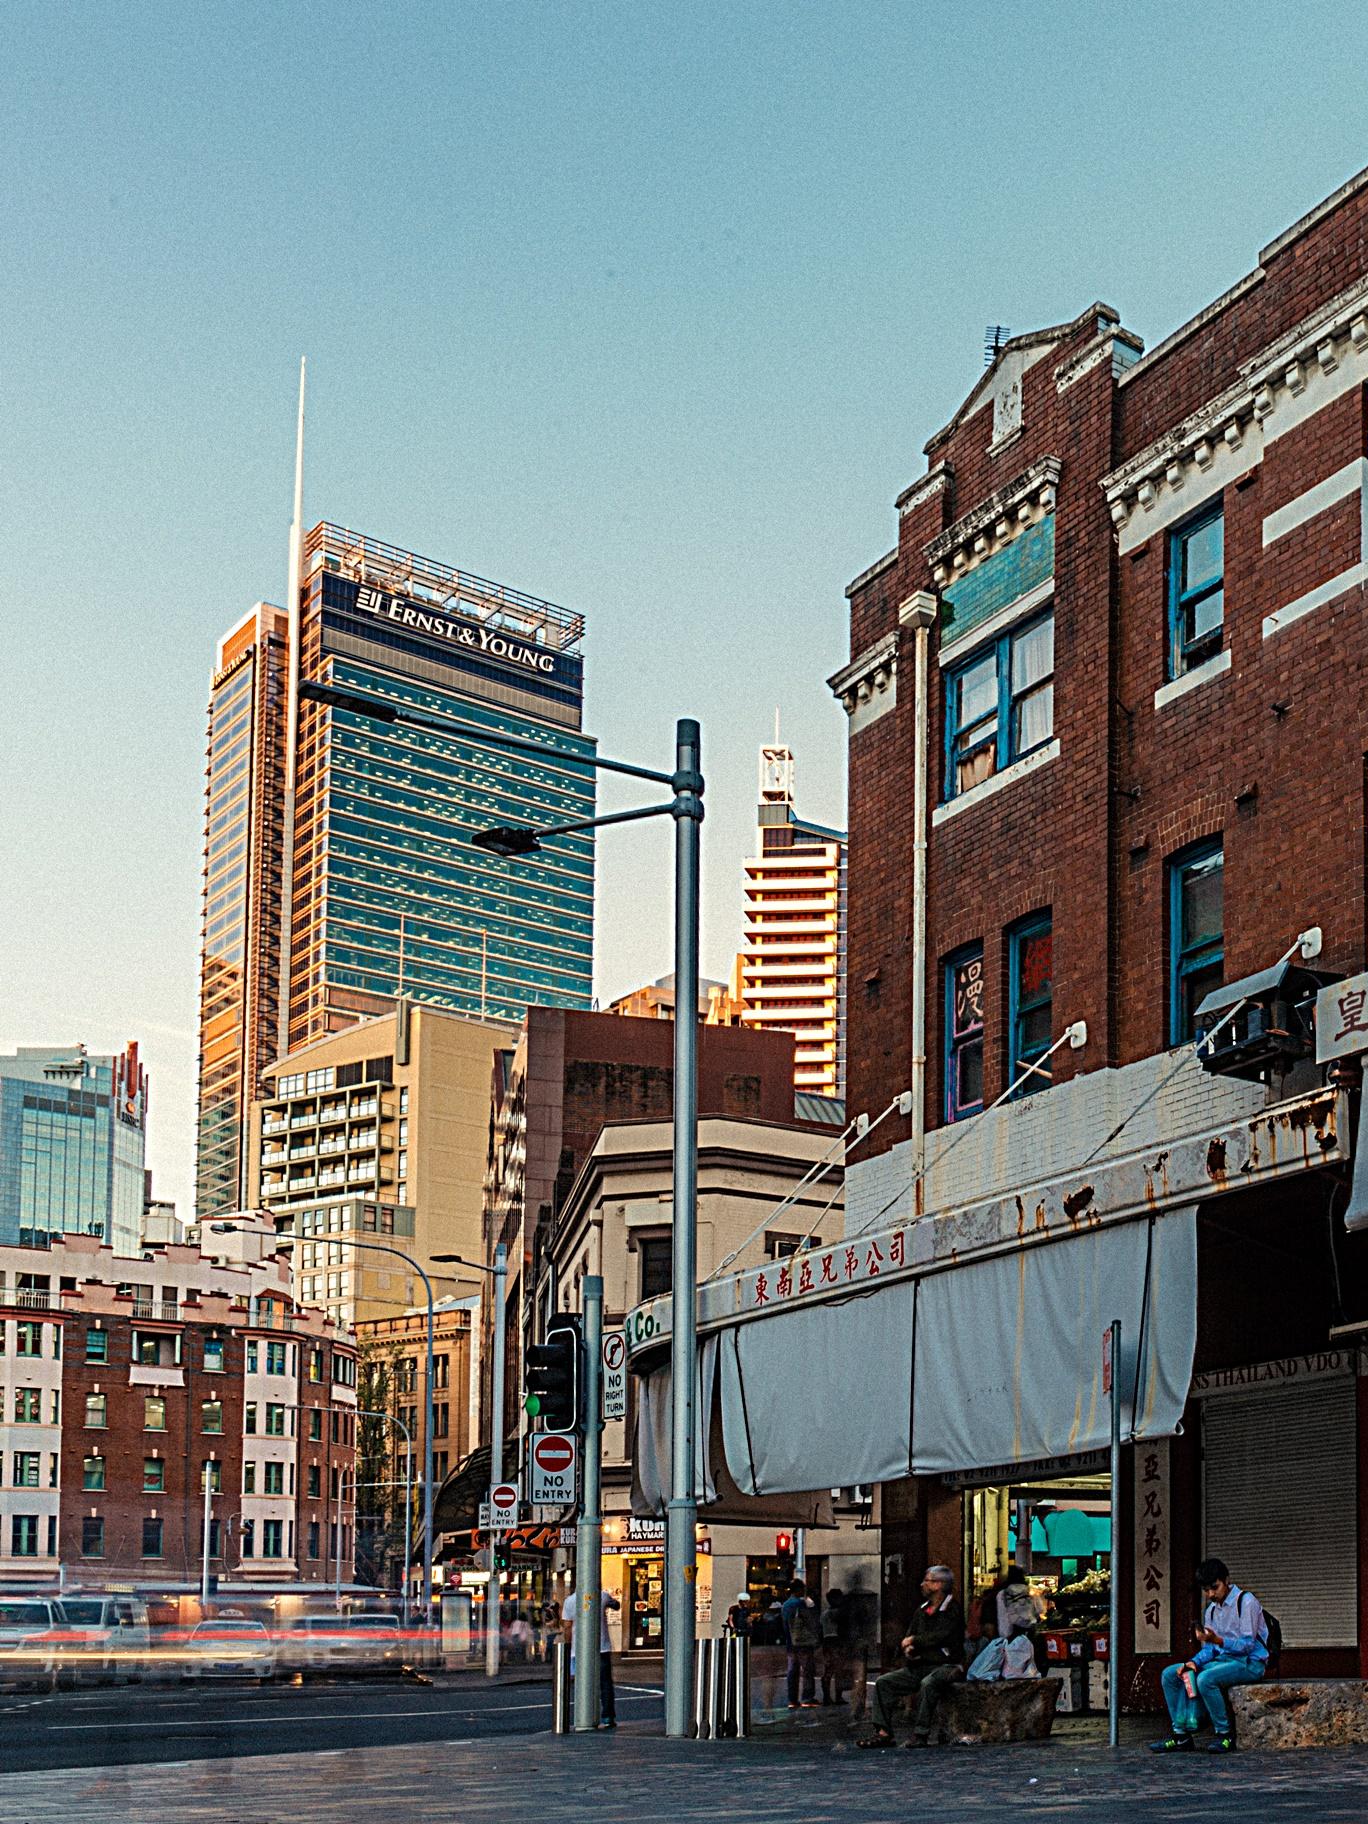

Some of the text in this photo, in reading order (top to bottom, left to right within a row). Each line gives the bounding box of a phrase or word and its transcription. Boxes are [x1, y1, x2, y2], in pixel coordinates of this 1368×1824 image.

[388, 599, 554, 672] ERNST & YOUNG
[754, 1231, 905, 1306] 東南亞兄弟公司
[1215, 1359, 1298, 1387] THAILAND
[1304, 1352, 1341, 1373] VDO
[608, 1374, 622, 1387] NO
[605, 1390, 624, 1401] RIGHT
[606, 1403, 624, 1412] TURN
[543, 1475, 564, 1487] NO
[535, 1489, 572, 1500] ENTRY
[497, 1510, 511, 1518] NO
[1141, 1440, 1164, 1630] 亞兄弟公司
[620, 1545, 653, 1553] JAPANESE
